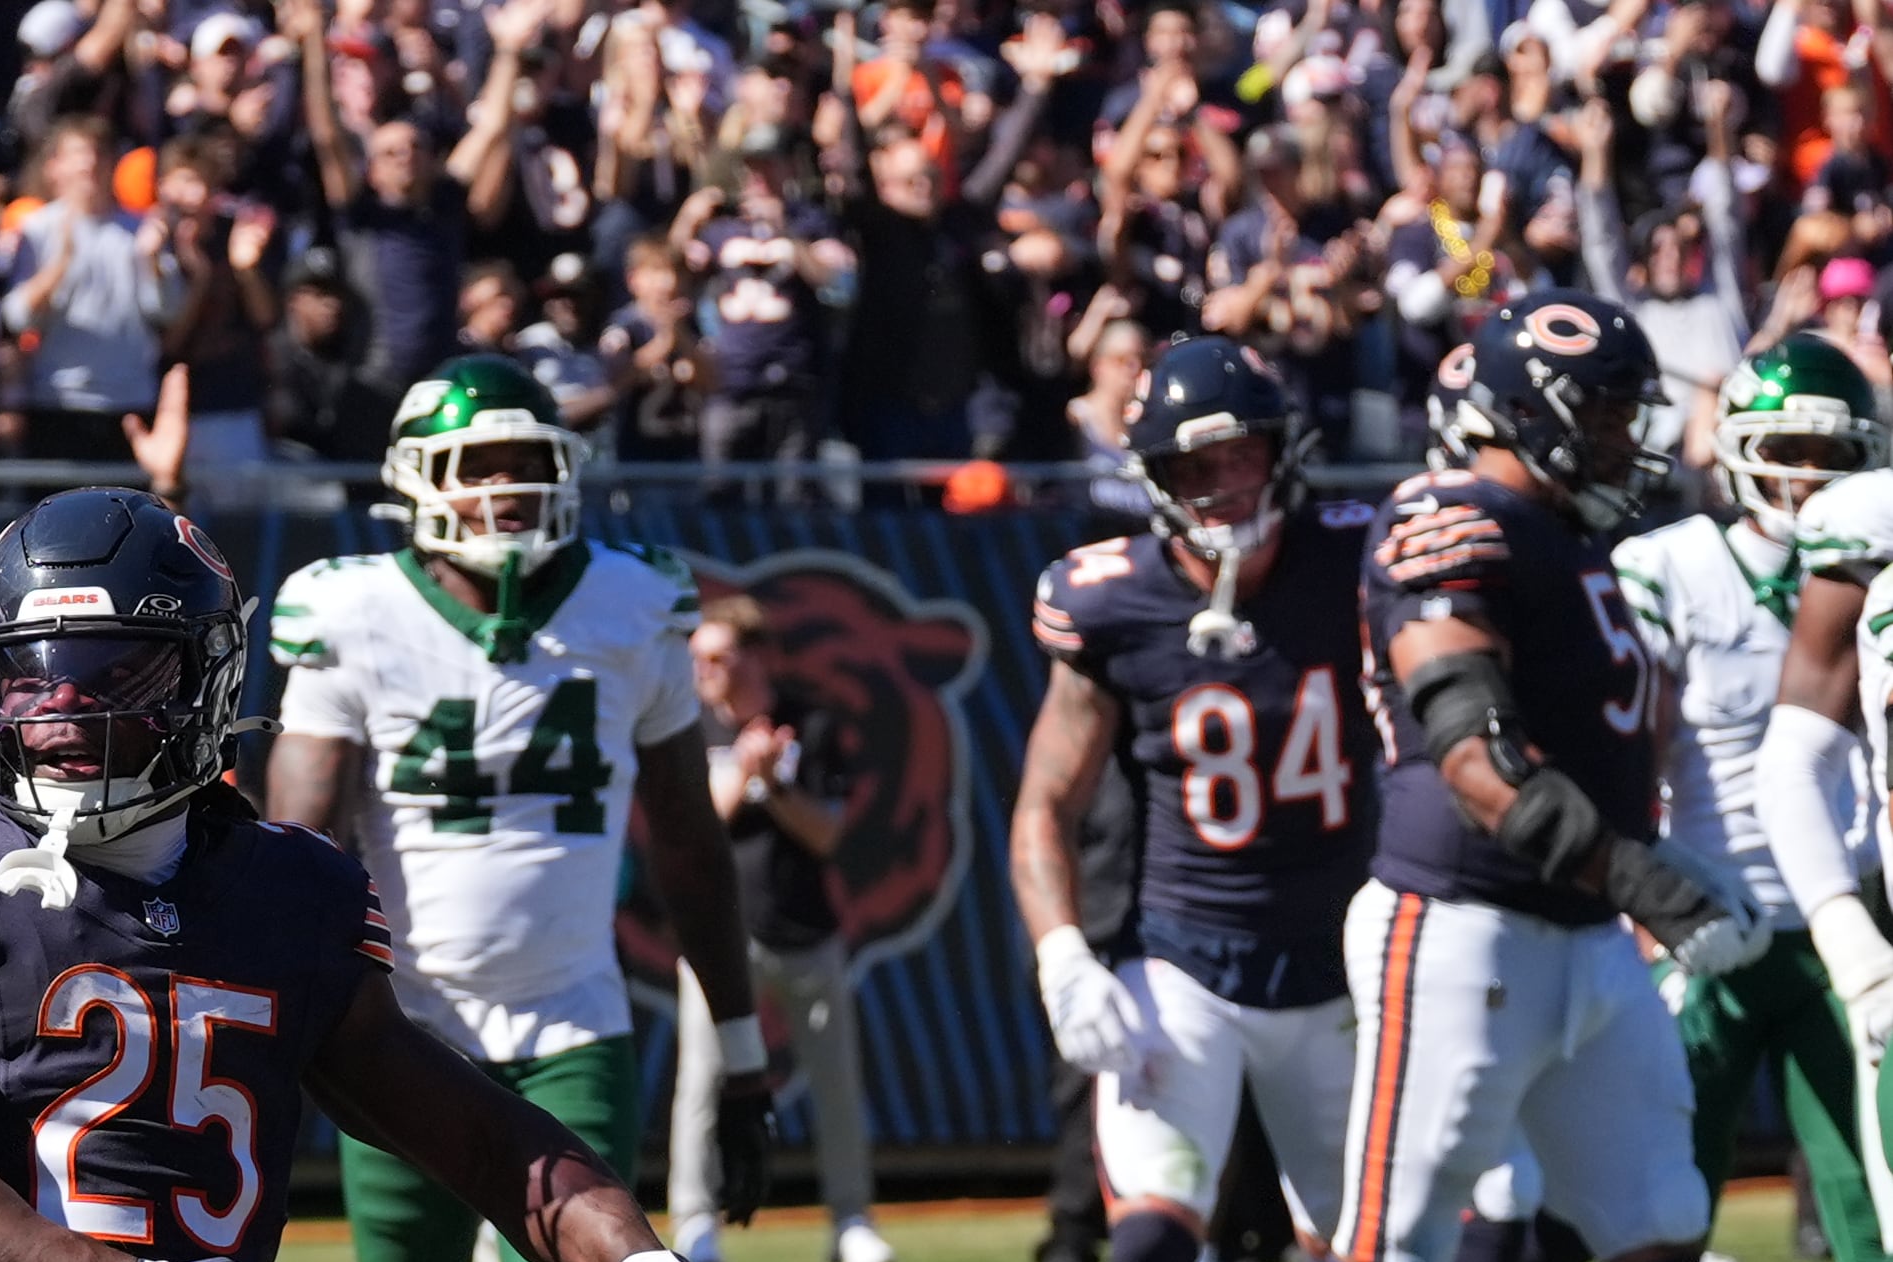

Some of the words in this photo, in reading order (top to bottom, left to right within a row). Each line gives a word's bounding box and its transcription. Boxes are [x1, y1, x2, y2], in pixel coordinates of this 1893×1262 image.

[33, 594, 99, 607] BEARS
[389, 678, 614, 836] 44
[1172, 664, 1354, 851] 84
[30, 962, 279, 1256] 25
